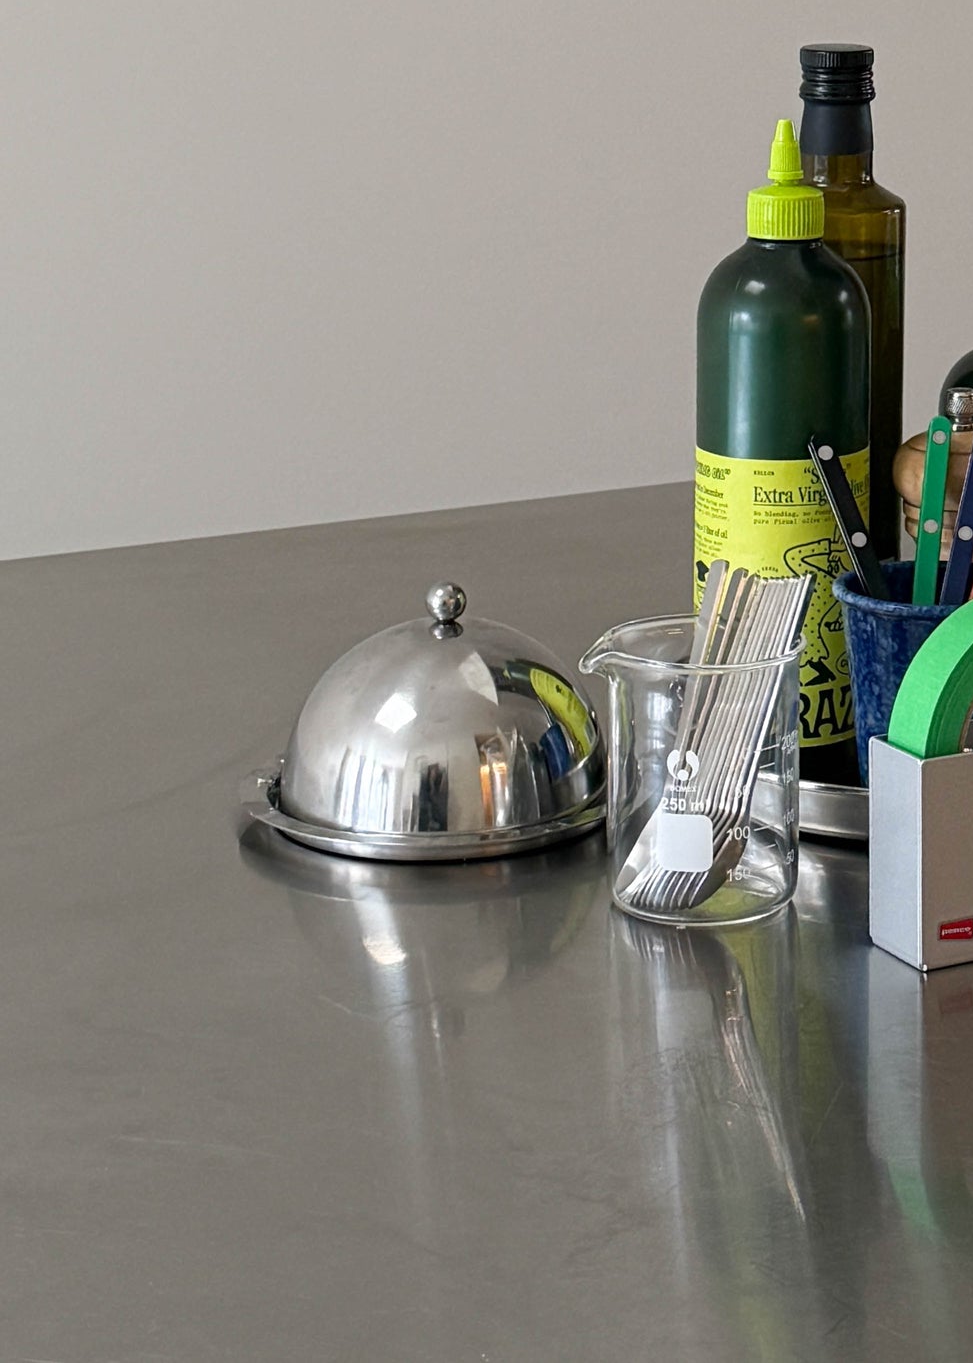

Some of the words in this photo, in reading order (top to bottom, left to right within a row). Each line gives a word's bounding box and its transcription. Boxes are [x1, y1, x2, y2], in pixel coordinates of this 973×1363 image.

[753, 486, 794, 504] Extra
[798, 486, 828, 506] Virg
[799, 684, 855, 739] RAZ
[660, 797, 687, 811] 250
[726, 826, 751, 841] 100
